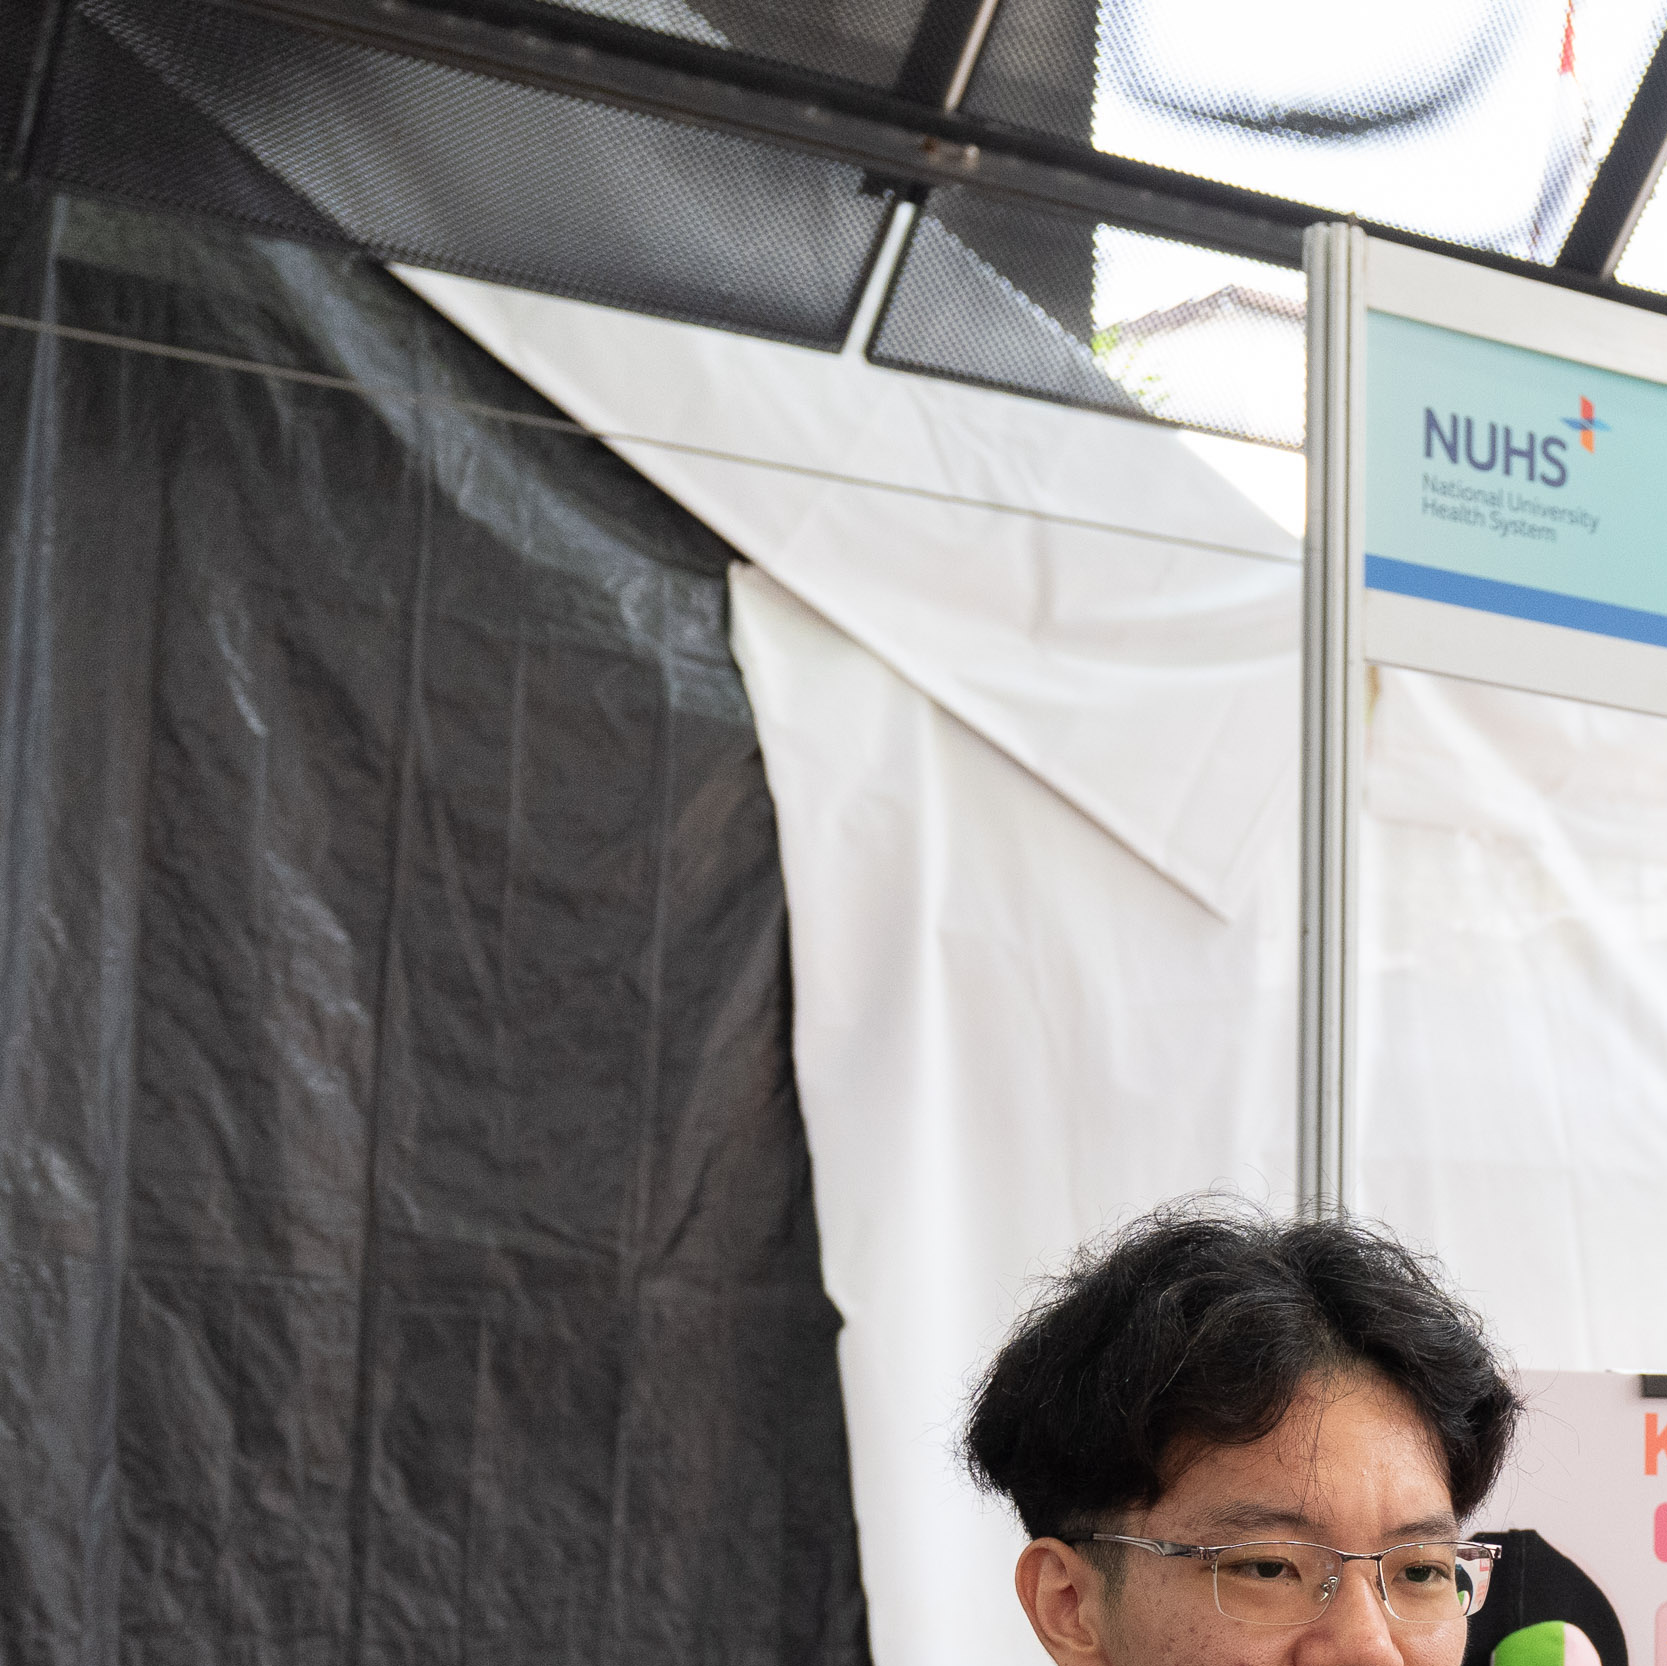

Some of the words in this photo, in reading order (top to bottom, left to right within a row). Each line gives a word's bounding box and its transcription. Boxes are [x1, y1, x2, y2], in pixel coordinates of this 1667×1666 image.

[1424, 406, 1567, 487] NUHS
[1422, 473, 1504, 508] National
[1507, 490, 1600, 535] University
[1422, 496, 1487, 527] Health
[1488, 508, 1556, 543] System
